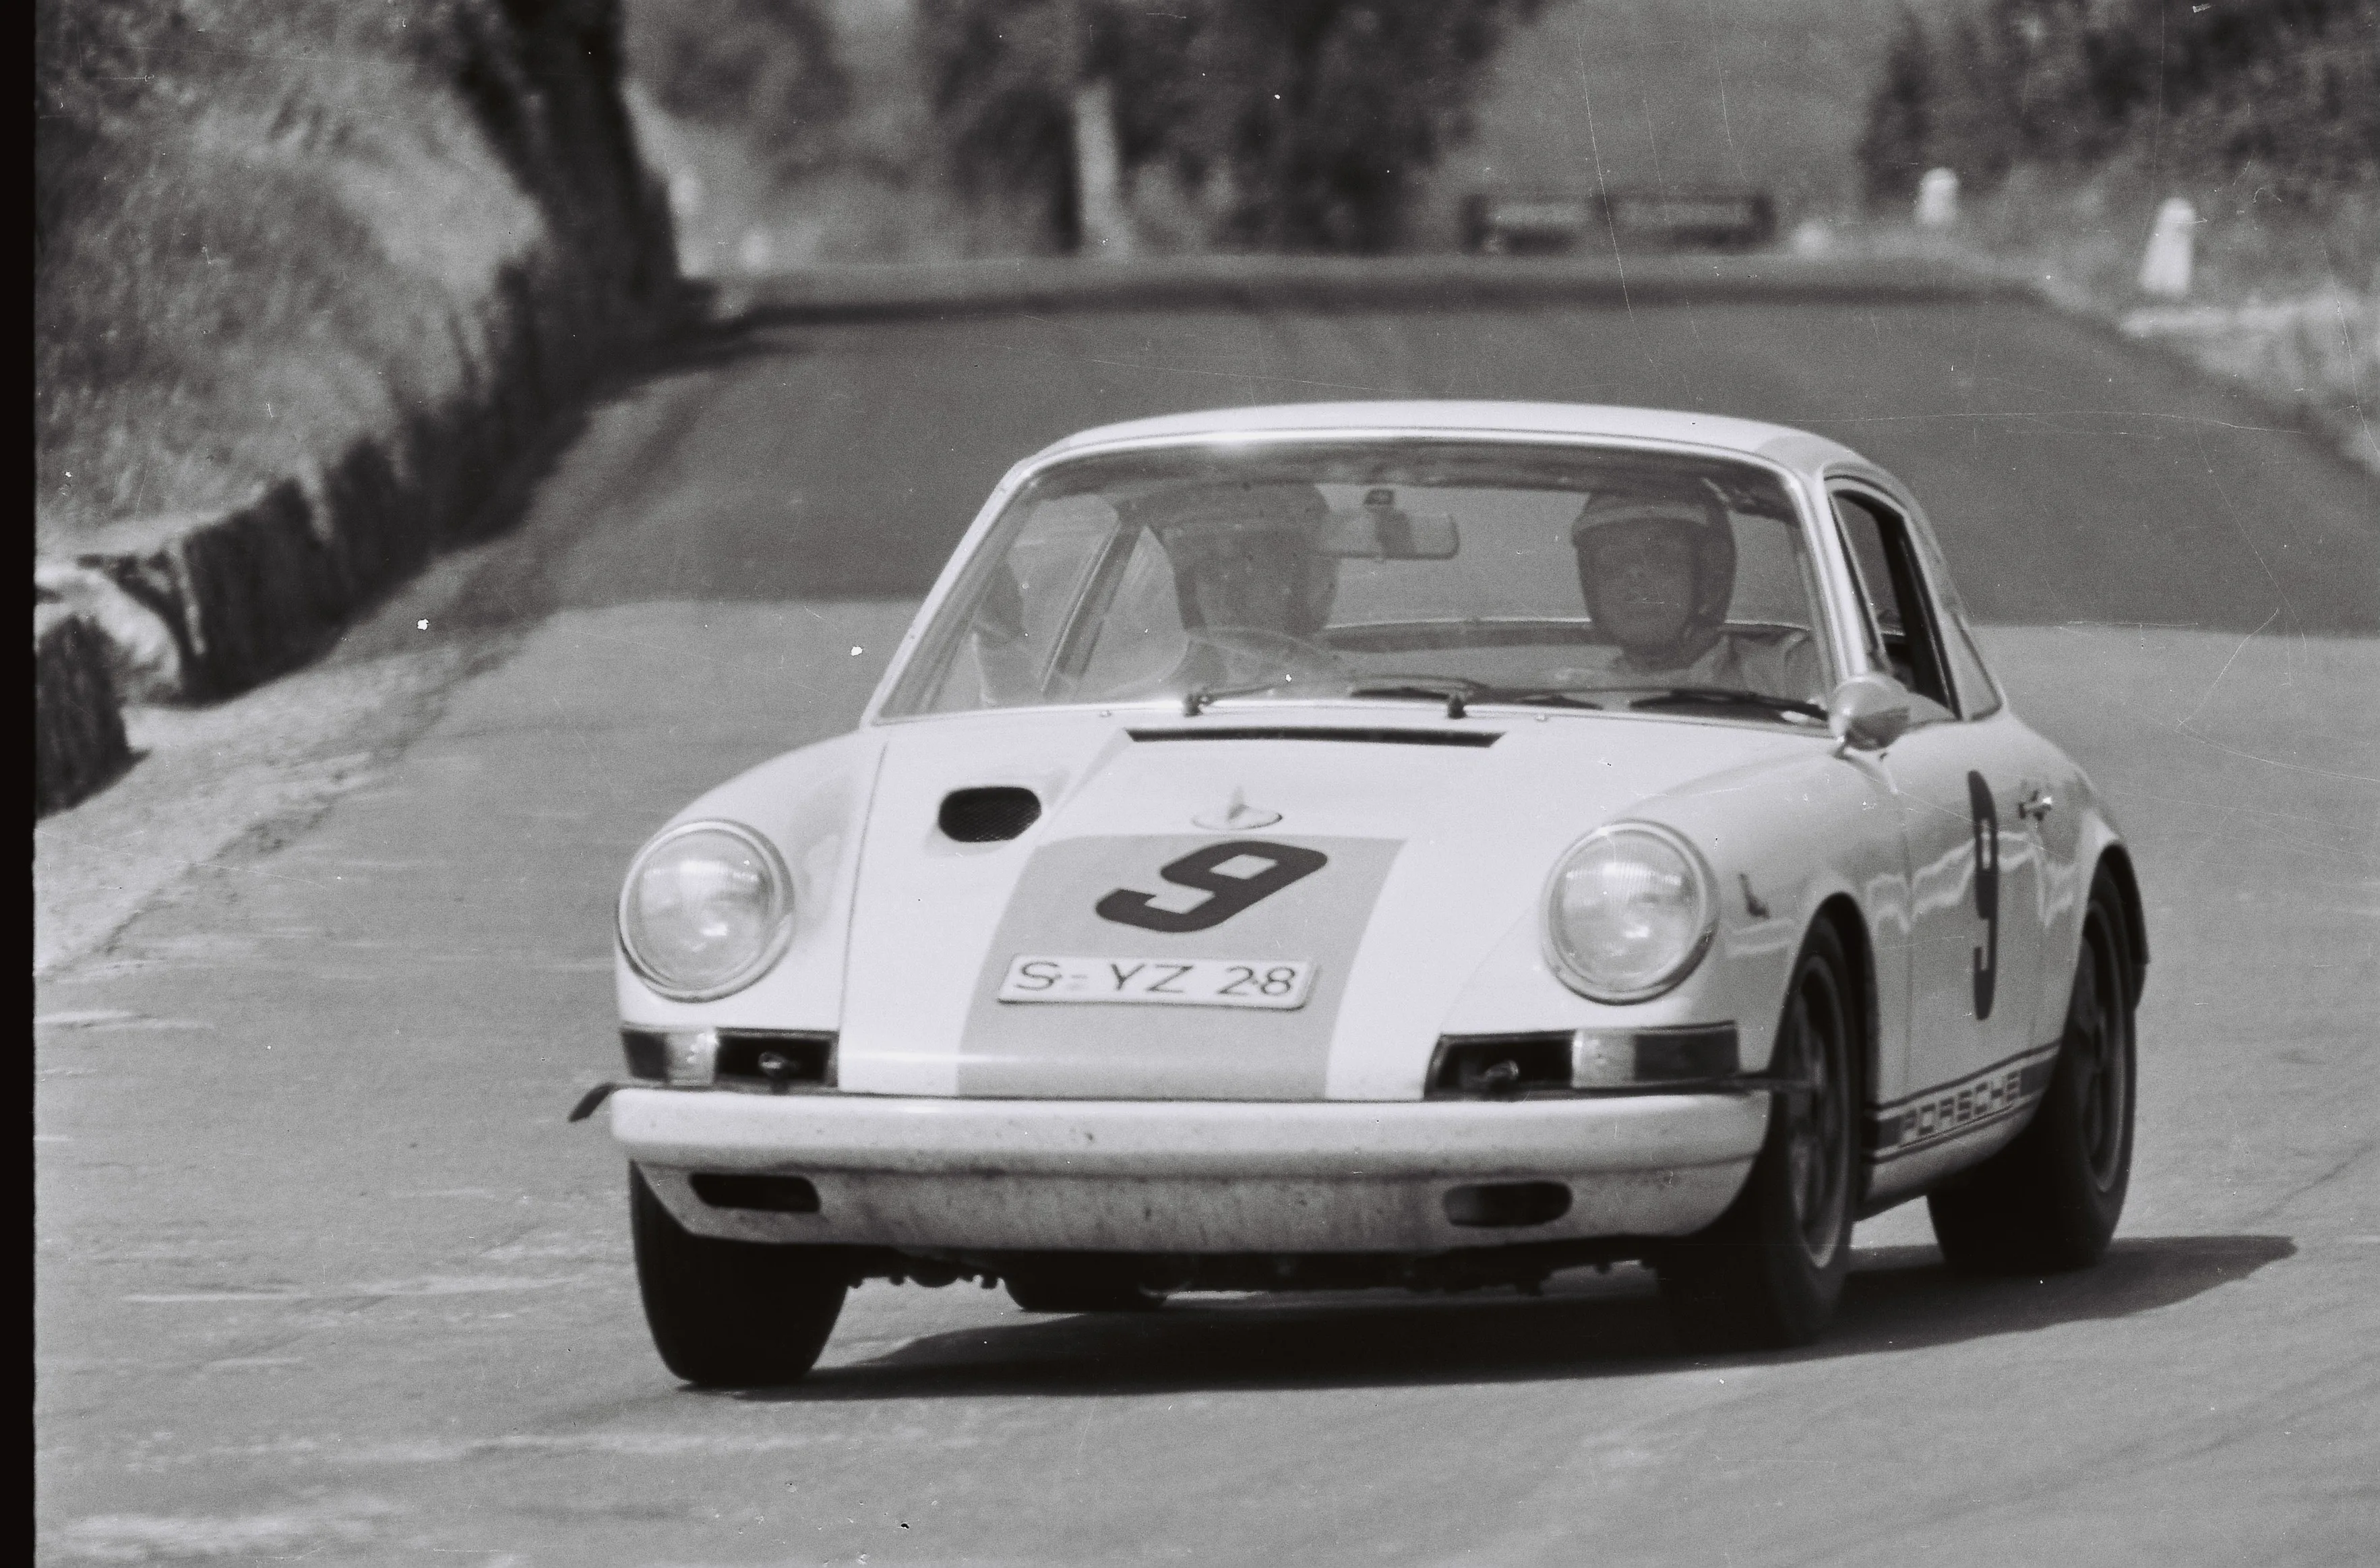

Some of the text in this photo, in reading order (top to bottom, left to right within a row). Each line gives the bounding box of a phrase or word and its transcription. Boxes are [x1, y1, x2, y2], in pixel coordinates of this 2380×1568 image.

[1095, 840, 1328, 934] 9
[1967, 770, 1998, 1021] 9
[1217, 965, 1296, 996] 28
[1901, 1070, 2020, 1143] PORSCHE
